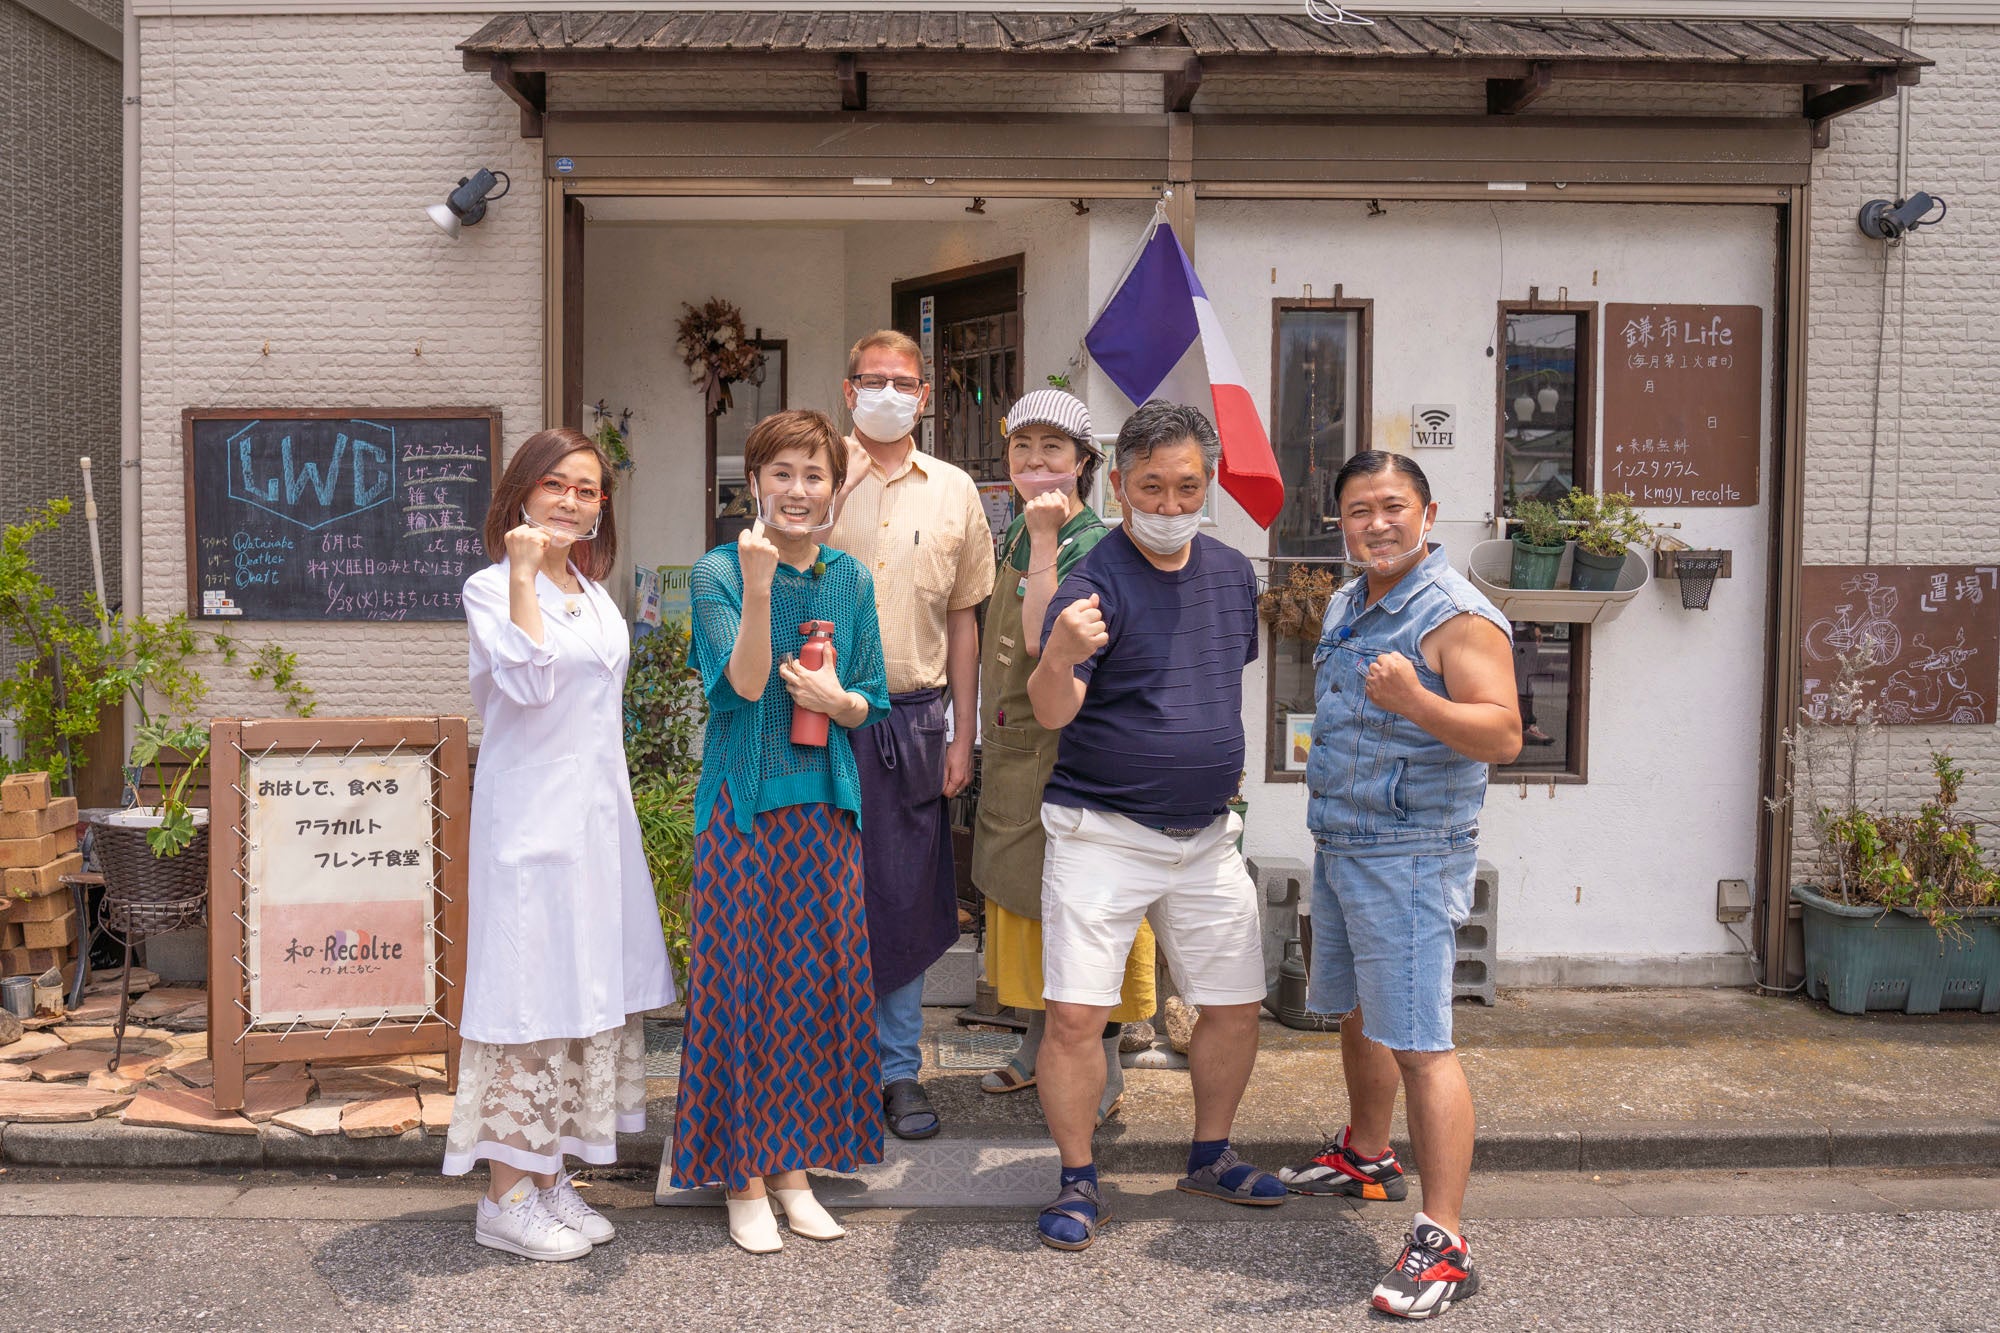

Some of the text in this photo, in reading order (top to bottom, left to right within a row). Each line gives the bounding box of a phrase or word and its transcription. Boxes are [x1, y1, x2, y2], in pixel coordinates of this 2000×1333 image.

[1644, 380, 1654, 393] 月
[1707, 416, 1717, 429] 日
[1416, 431, 1453, 445] WIFI
[1611, 461, 1699, 478] インスタグラム
[408, 486, 449, 506] 雑貨
[295, 819, 382, 836] アラカルト
[314, 850, 420, 868] フレンチ食堂
